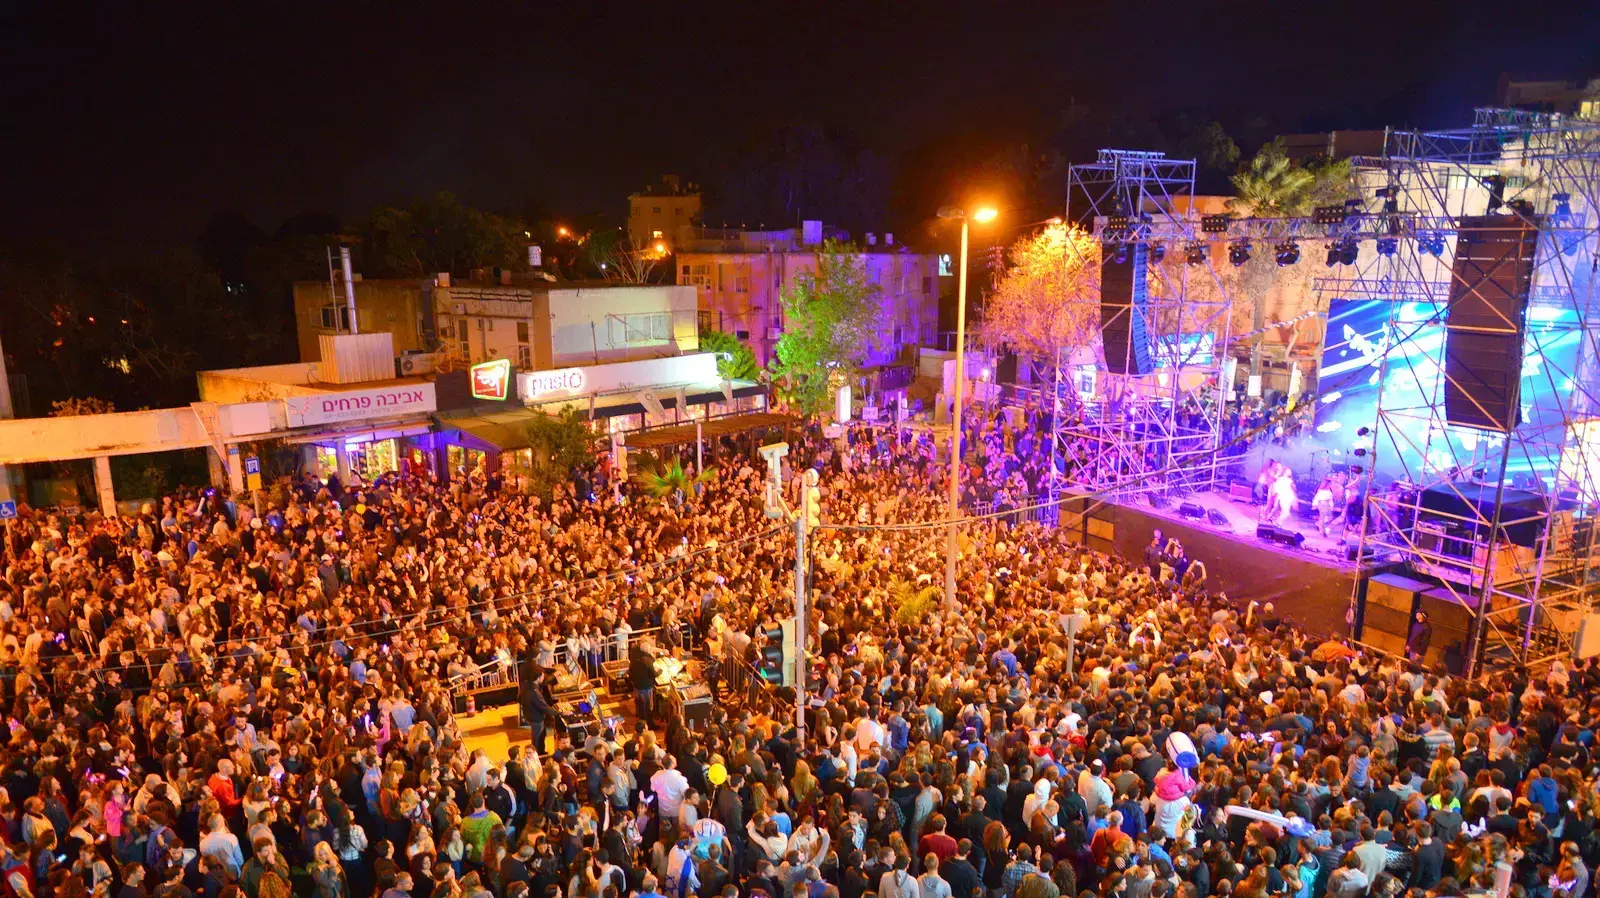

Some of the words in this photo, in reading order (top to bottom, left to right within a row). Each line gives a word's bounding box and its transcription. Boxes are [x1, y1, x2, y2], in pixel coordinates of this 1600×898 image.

[532, 372, 582, 395] pasto
[322, 396, 371, 412] פרחים
[377, 391, 423, 406] אביבה
